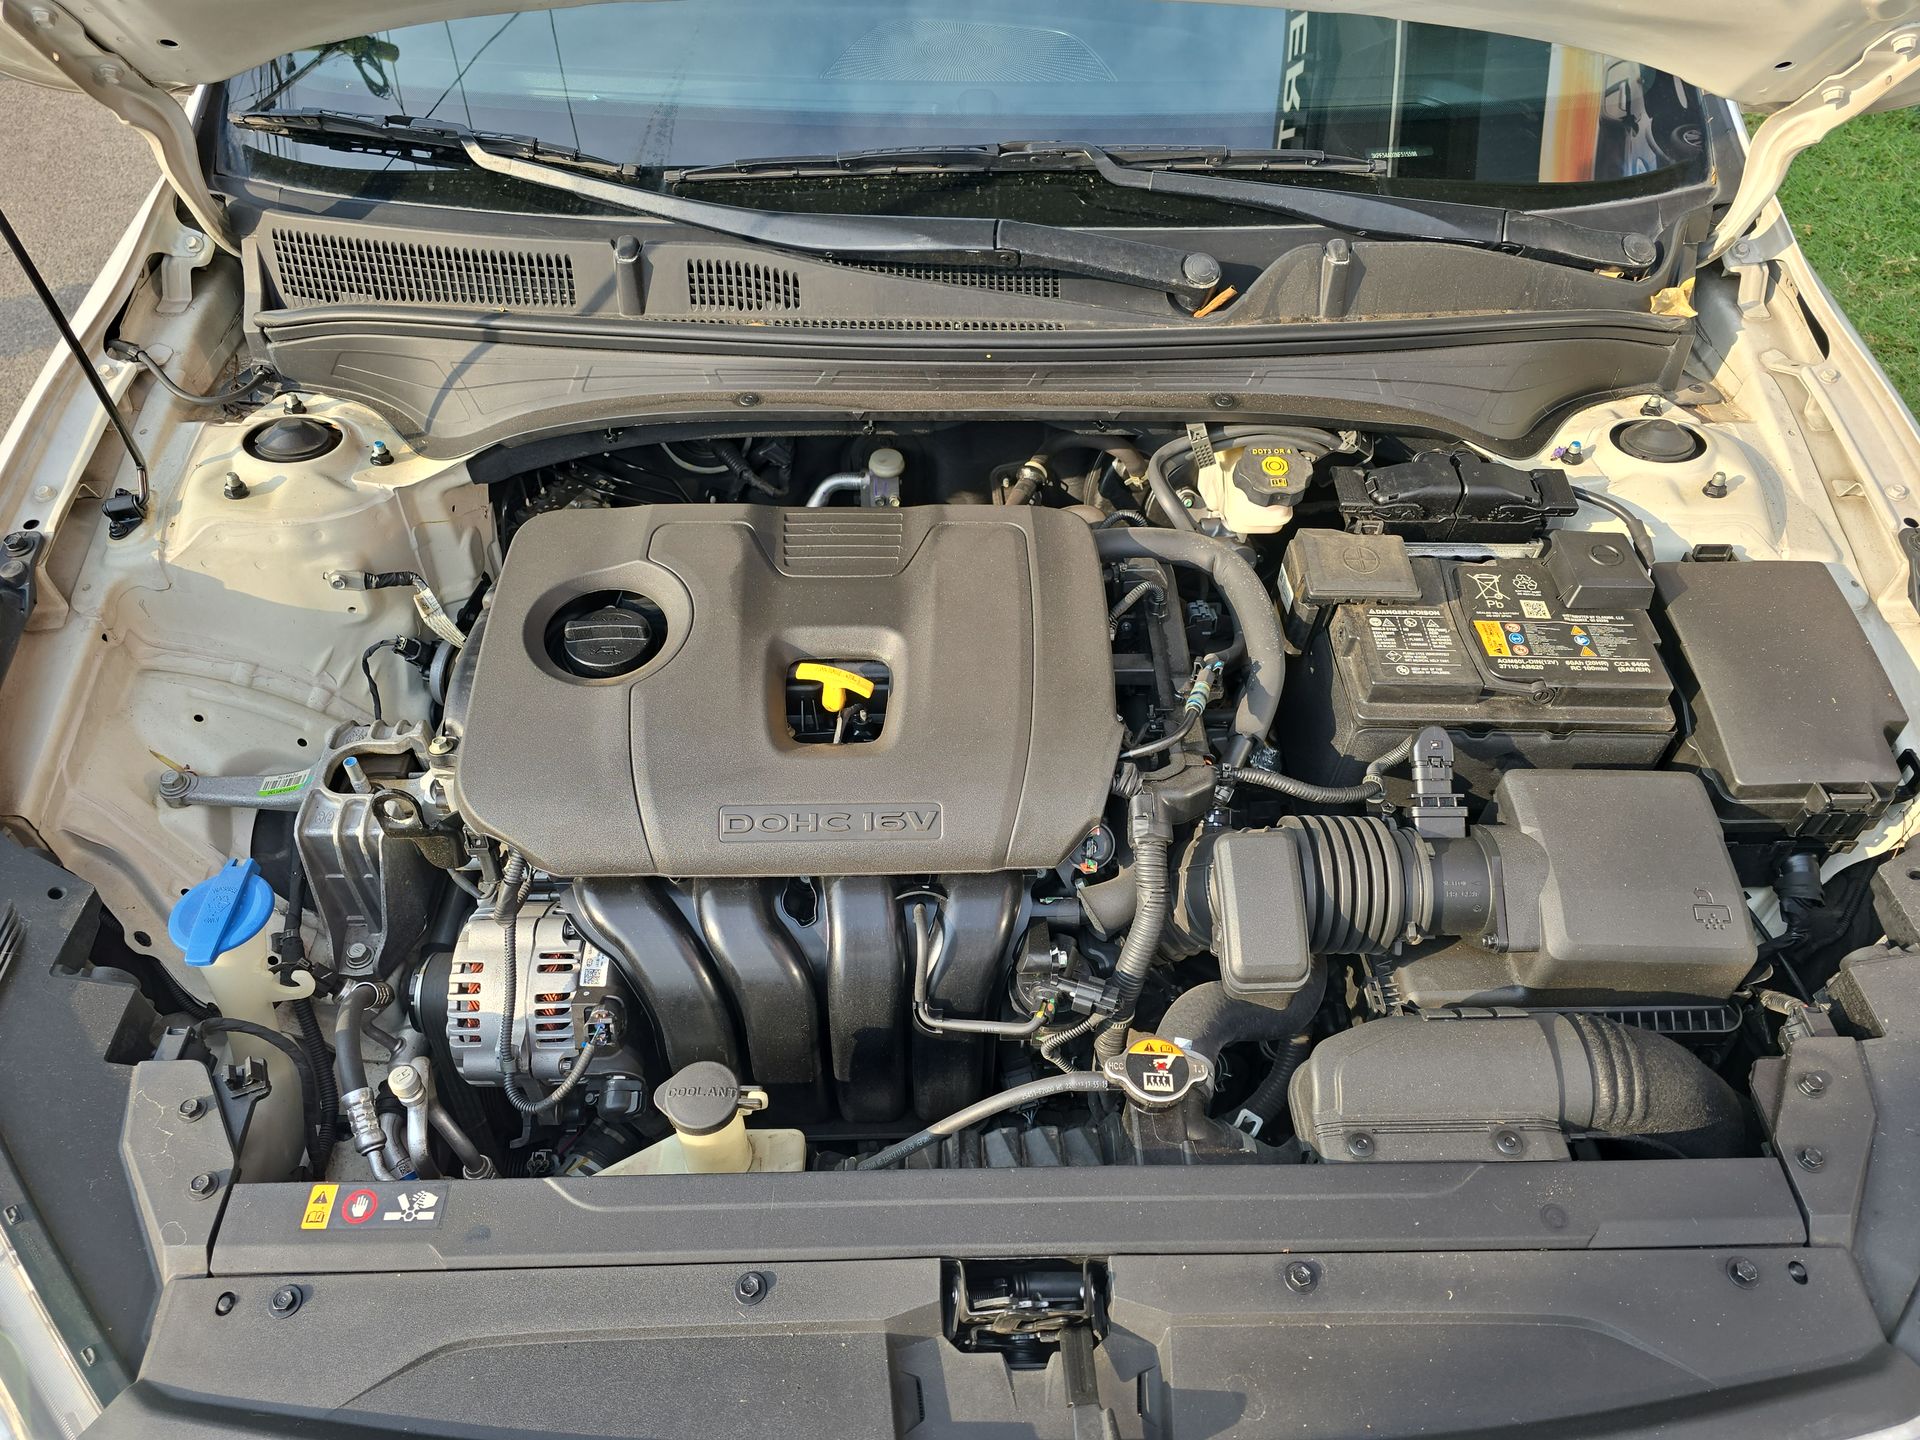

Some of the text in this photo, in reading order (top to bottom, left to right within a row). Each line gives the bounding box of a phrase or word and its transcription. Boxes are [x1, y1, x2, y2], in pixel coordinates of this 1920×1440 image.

[1486, 600, 1504, 609] Pb
[723, 811, 940, 834] DOHC 16V
[1193, 1065, 1206, 1073] 1.1
[668, 1086, 738, 1099] COOLANT
